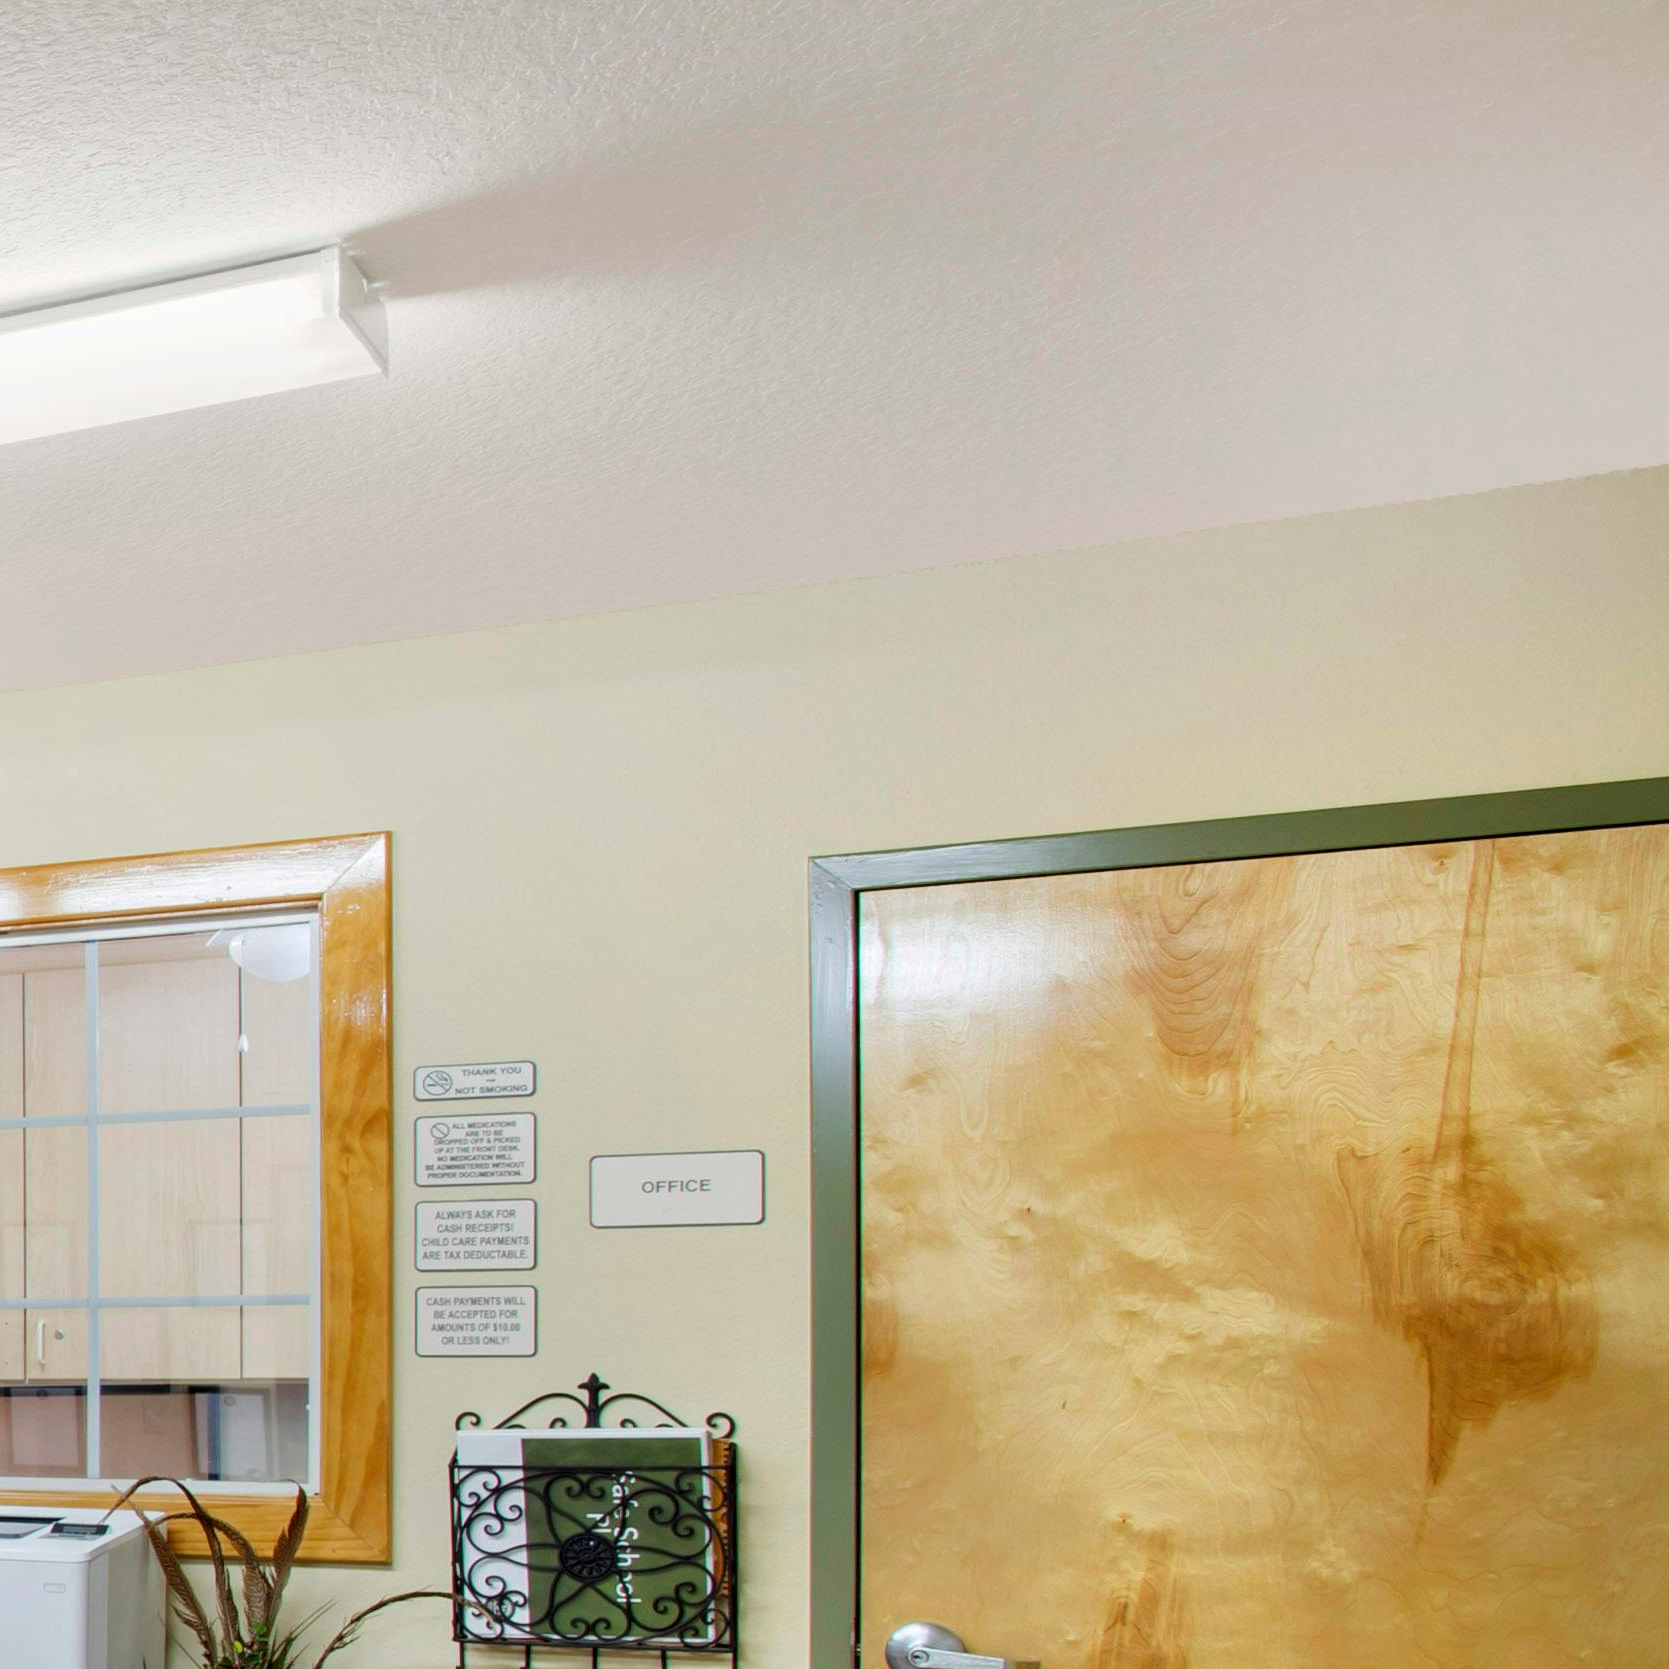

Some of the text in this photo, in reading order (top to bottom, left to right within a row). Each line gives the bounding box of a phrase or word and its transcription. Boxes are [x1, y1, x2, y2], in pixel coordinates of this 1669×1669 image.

[455, 1085, 527, 1095] NOT SMOKING
[642, 1179, 711, 1193] OFFICE
[435, 1210, 516, 1219] ALWAYS ASK FOR
[437, 1223, 513, 1233] CASH RECEIPTS!
[422, 1236, 529, 1246] CHILD CARE PAYMENTS
[423, 1250, 528, 1260] ARE TAX DEDUCTABLE.
[427, 1297, 526, 1306] CASH PAYMENTS WILL
[434, 1310, 518, 1319] BE ACCEPTED FOR
[431, 1323, 520, 1332] AMOUNTS OF $10.00
[441, 1336, 510, 1345] OR LESS ONLY!
